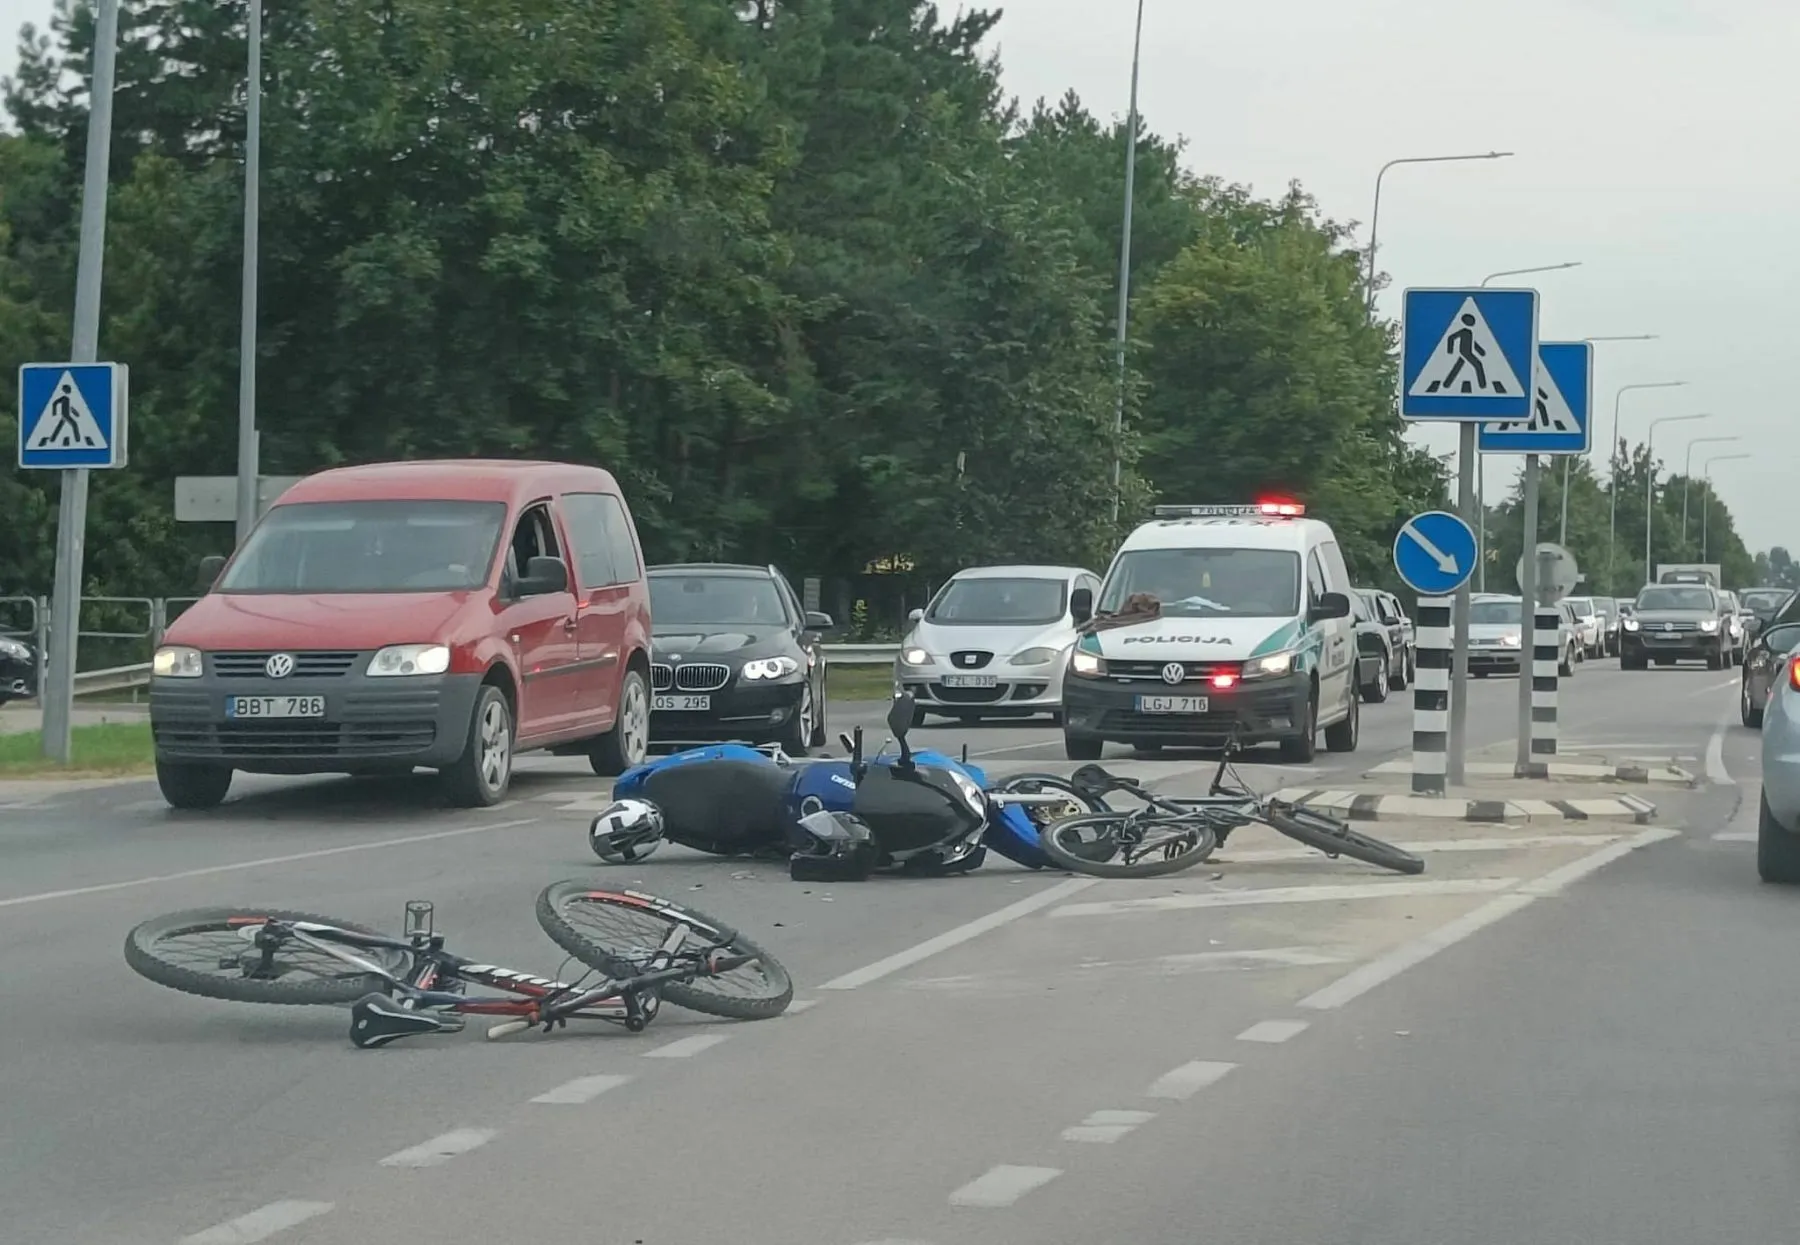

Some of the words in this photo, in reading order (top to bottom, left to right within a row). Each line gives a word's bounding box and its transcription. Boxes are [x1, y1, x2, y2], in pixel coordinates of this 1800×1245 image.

[1122, 635, 1233, 645] POLICIJA
[236, 698, 276, 715] BBT
[287, 698, 322, 715] 786
[1143, 698, 1173, 711] LGJ
[1181, 698, 1206, 711] 716
